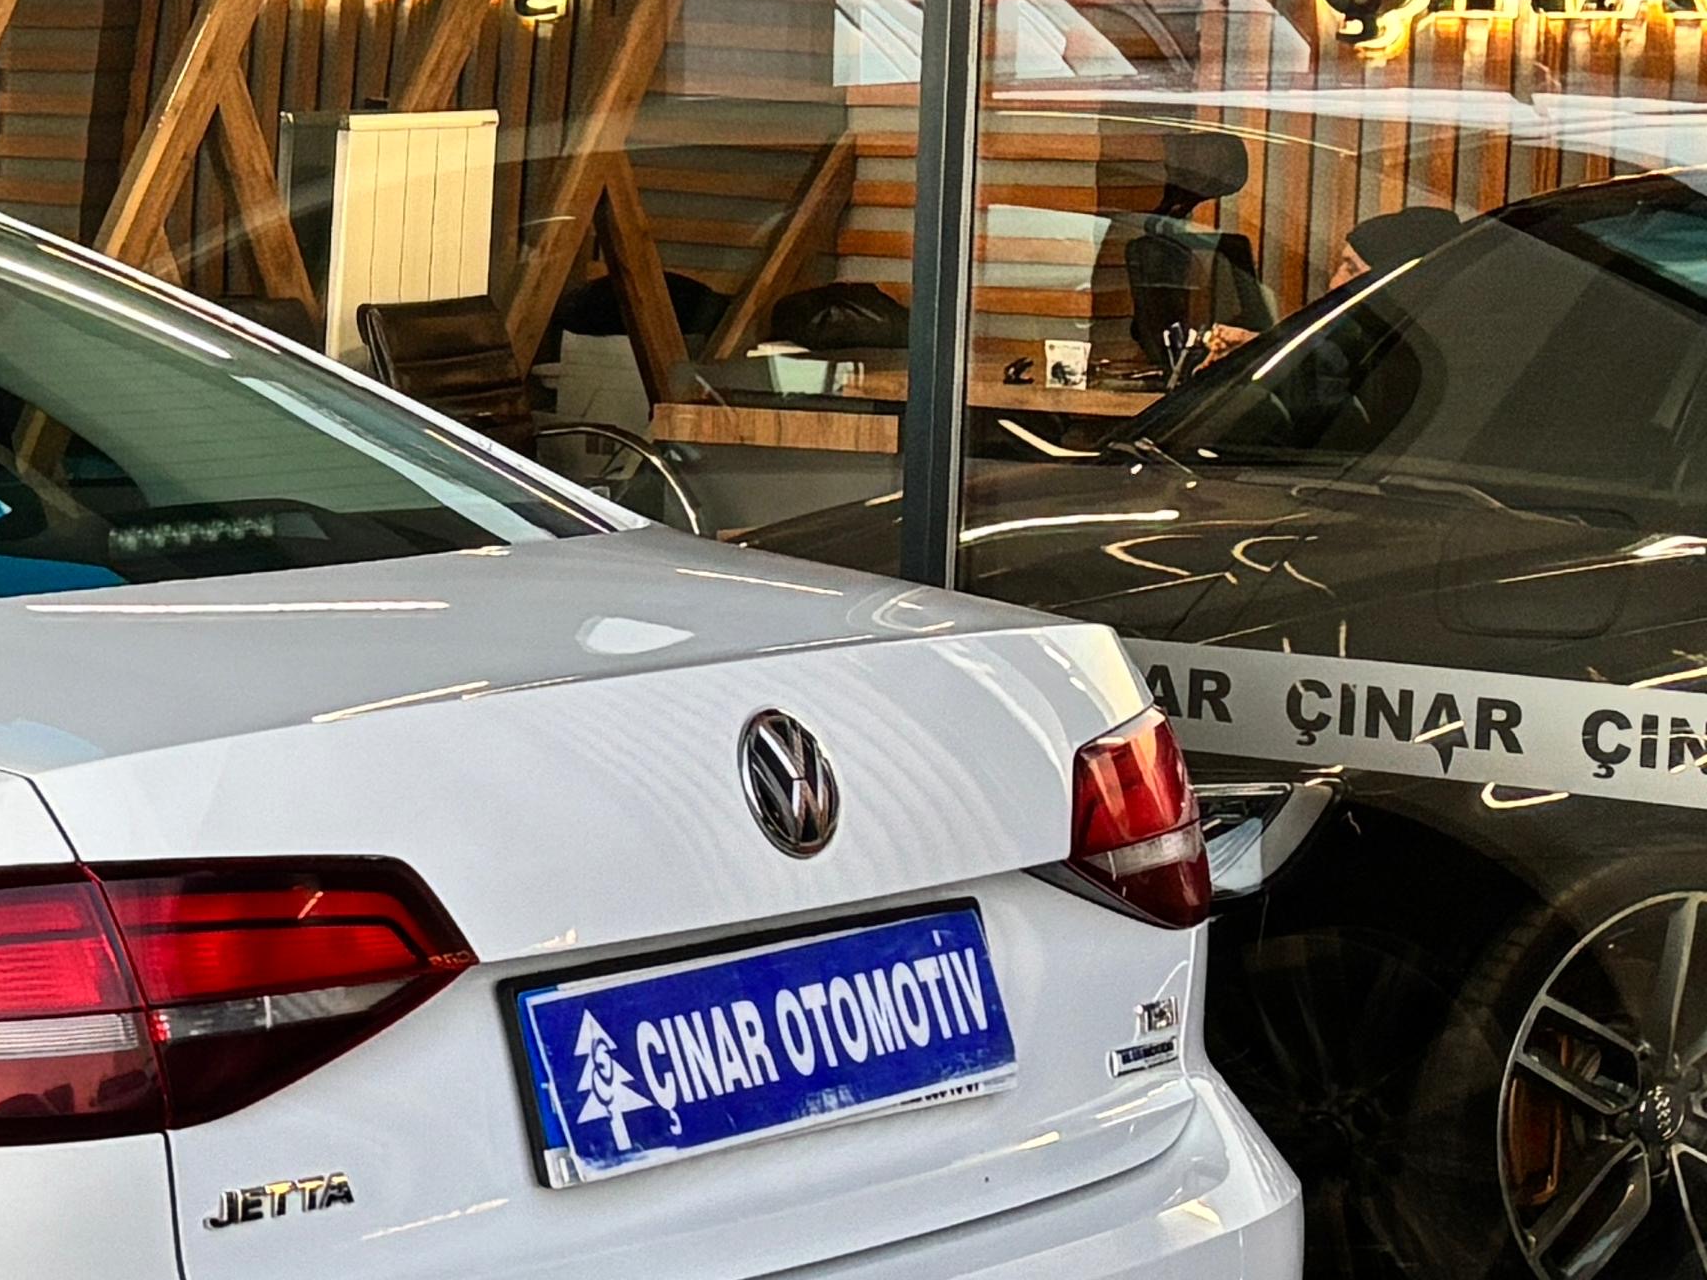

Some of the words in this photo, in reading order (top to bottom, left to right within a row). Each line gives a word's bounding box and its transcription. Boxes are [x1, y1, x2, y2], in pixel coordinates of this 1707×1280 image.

[1286, 678, 1524, 756] ÇINAR
[636, 1000, 780, 1136] ÇINAR
[774, 930, 988, 1077] OTOMOTİV
[203, 1171, 355, 1230] JETTA
